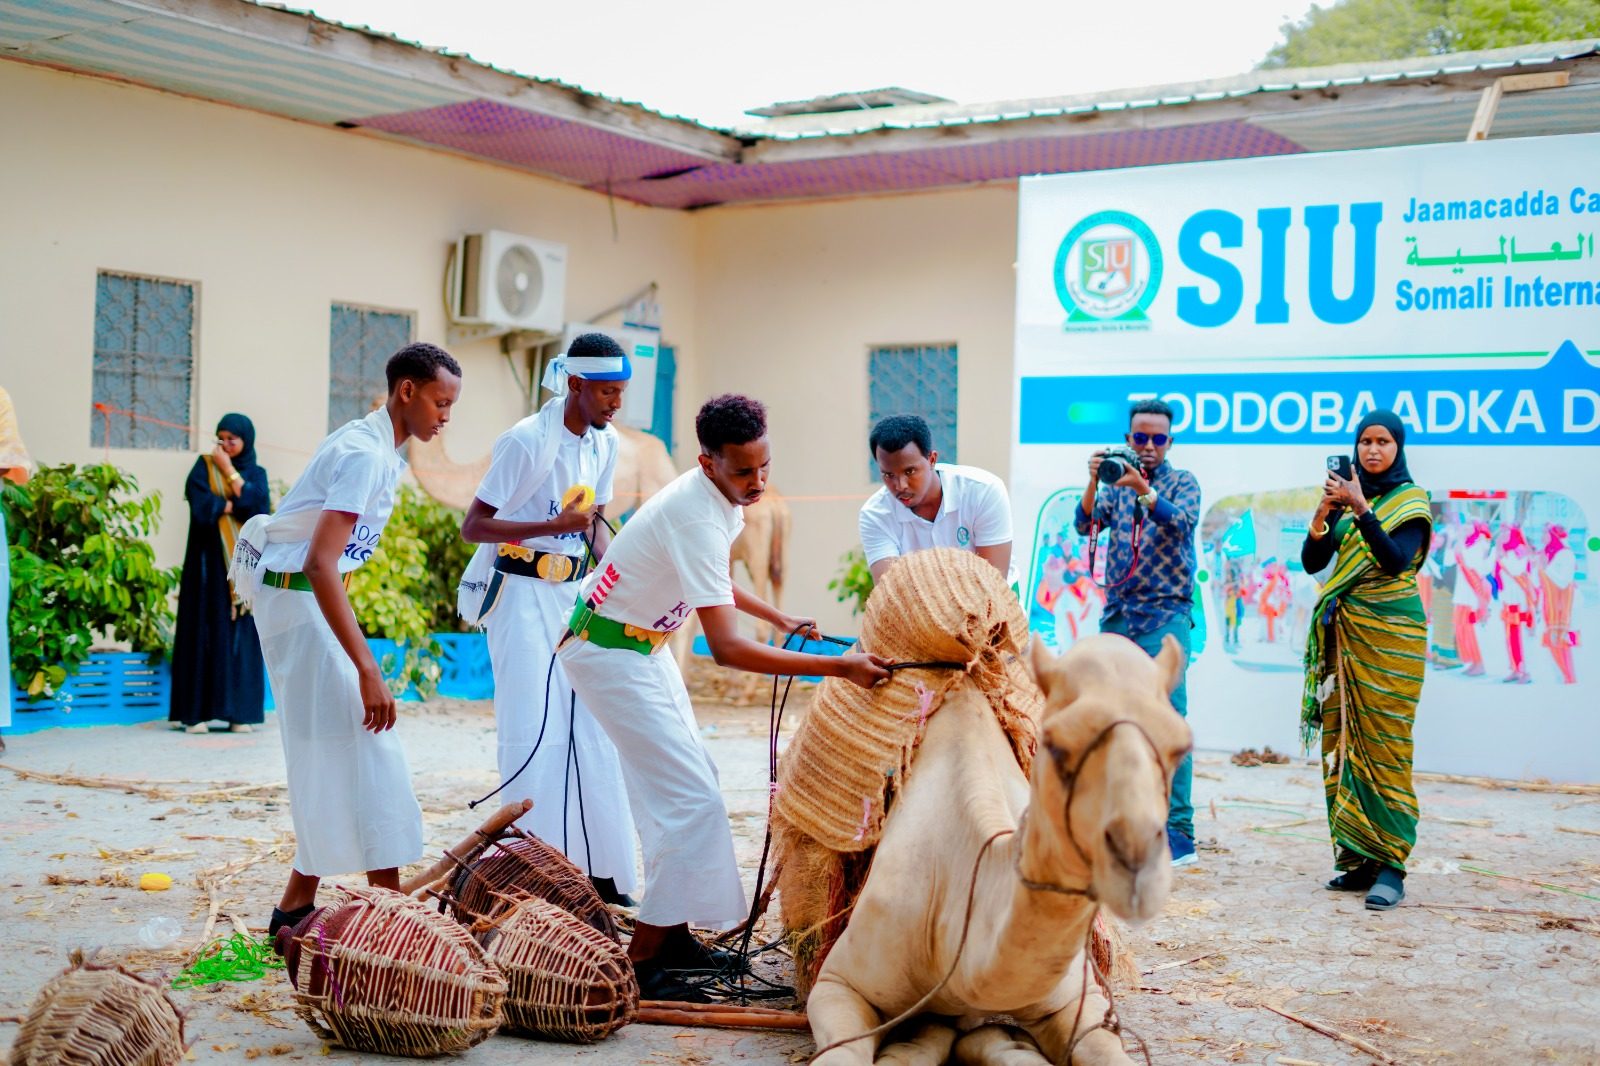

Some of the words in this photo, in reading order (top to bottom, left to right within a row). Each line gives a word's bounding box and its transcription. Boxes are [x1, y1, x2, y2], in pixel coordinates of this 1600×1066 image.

[1403, 190, 1559, 223] Jaamacadda
[1084, 242, 1132, 271] SIU
[1177, 202, 1383, 328] SIU
[1405, 232, 1594, 274] العالمية
[1396, 276, 1493, 311] Somali
[1127, 389, 1546, 433] ODDOBAADKA
